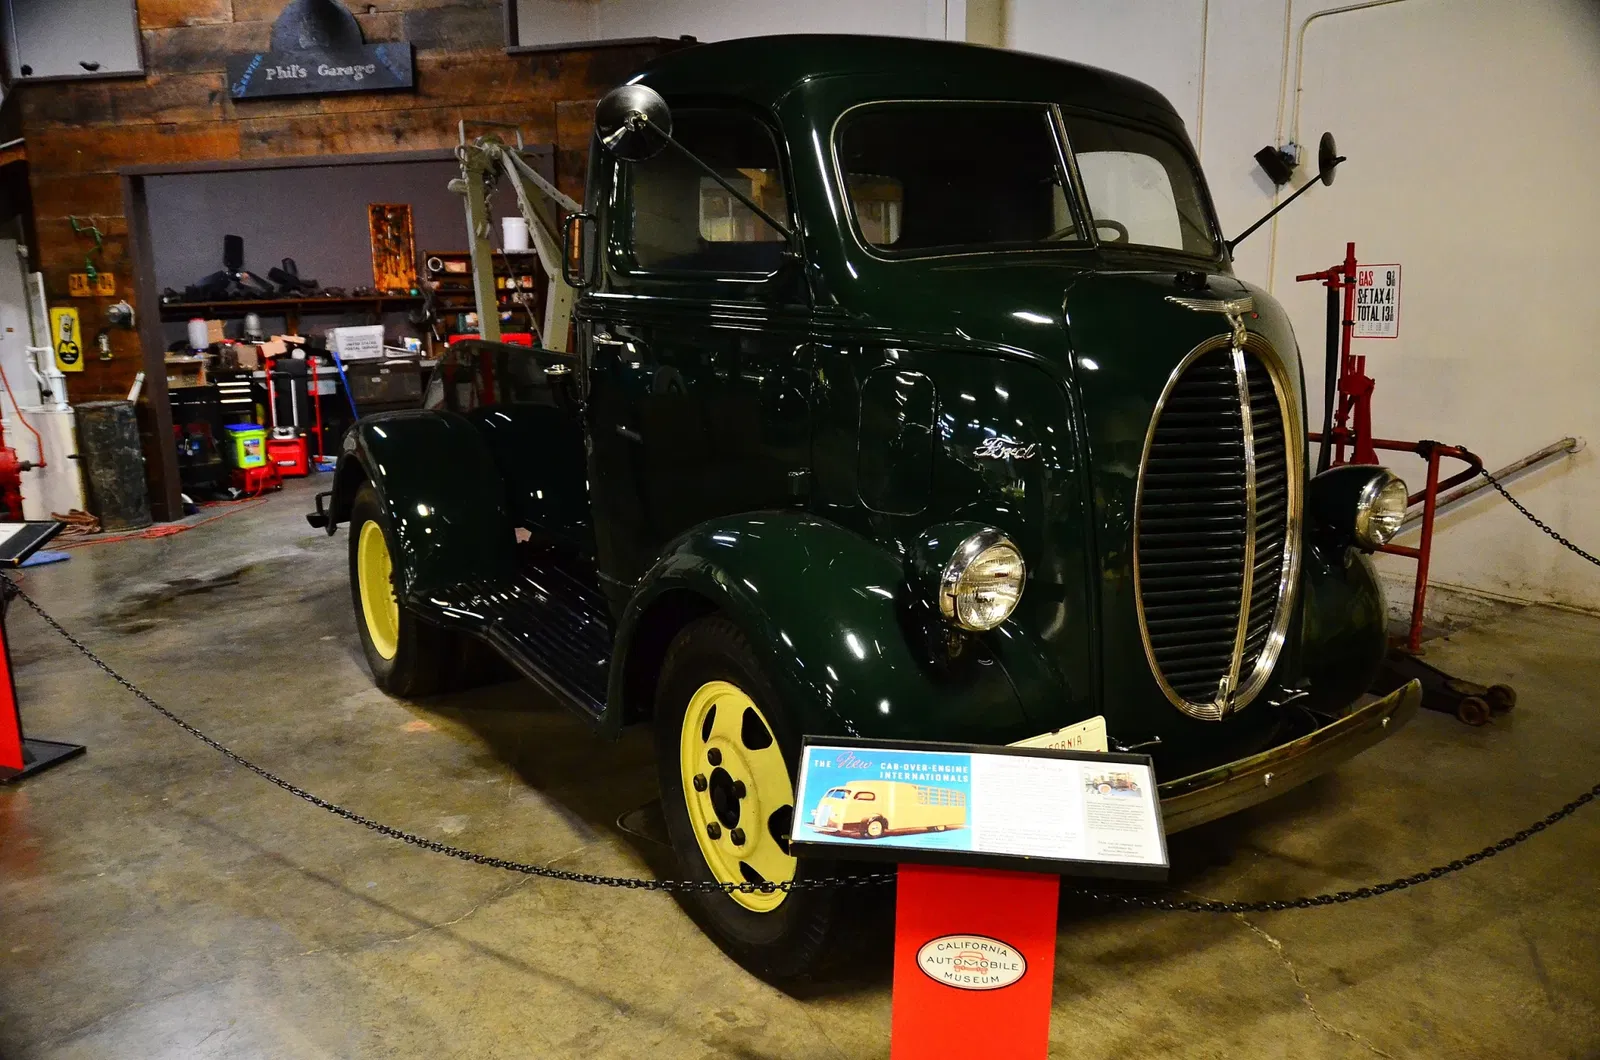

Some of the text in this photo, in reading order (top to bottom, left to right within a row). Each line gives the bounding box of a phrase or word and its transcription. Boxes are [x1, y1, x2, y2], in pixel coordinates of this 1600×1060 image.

[265, 64, 376, 81] Phil's Garage
[1359, 271, 1373, 286] GAS
[1370, 288, 1384, 304] TAX
[1357, 306, 1380, 321] TOTAL
[60, 342, 77, 354] AC
[973, 438, 1036, 459] Ford
[1045, 736, 1082, 750] FORNIA
[814, 751, 968, 773] THE New CAB-OVER-ENGINE
[880, 772, 969, 783] INTERNATIONALS
[937, 941, 1008, 957] CALIFORNIA
[926, 956, 1019, 971] AUTOMOBILE
[944, 972, 1000, 984] MUSEUM
